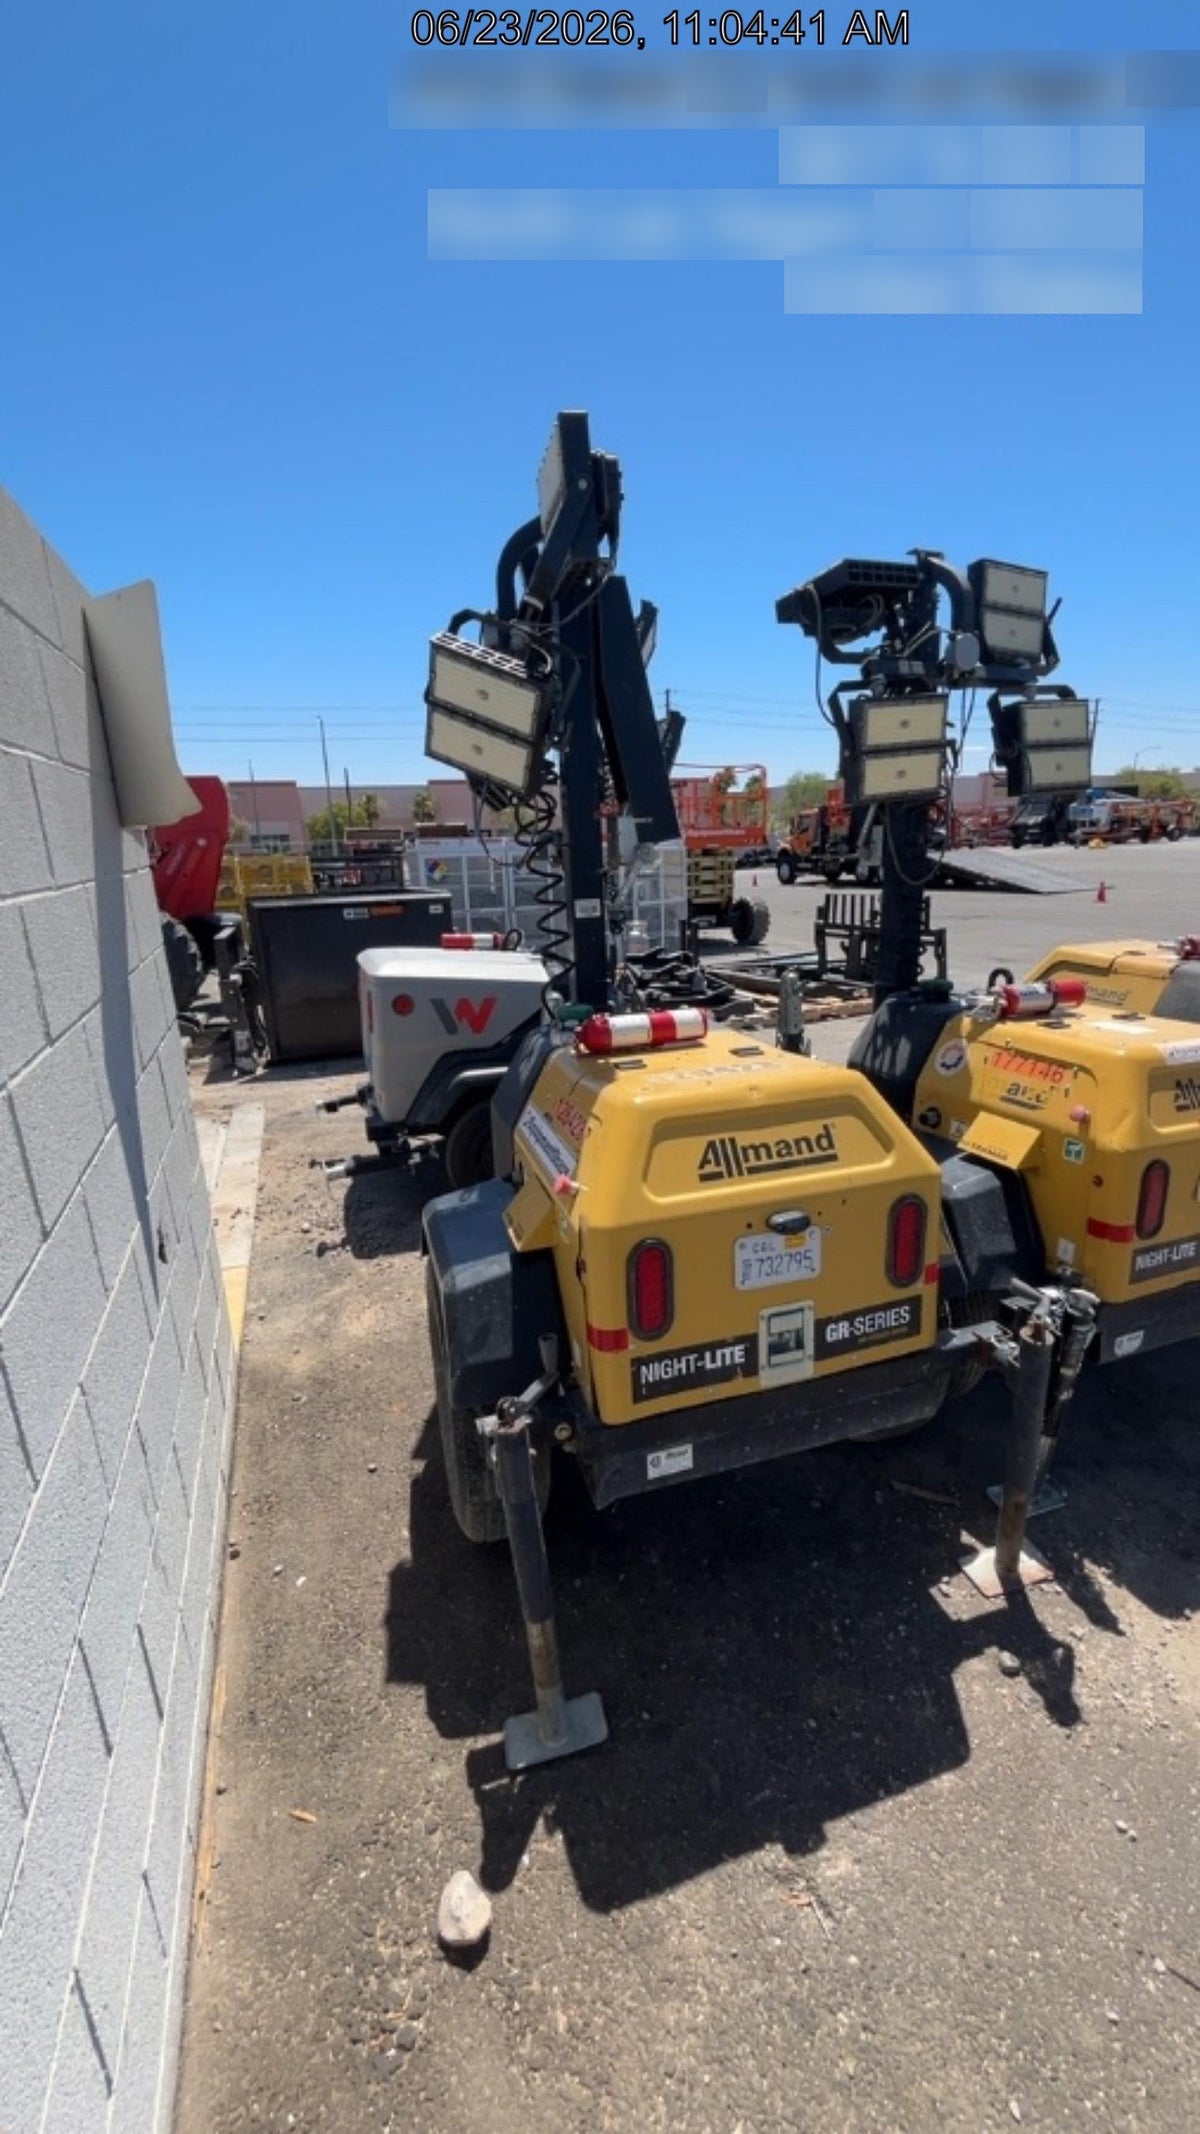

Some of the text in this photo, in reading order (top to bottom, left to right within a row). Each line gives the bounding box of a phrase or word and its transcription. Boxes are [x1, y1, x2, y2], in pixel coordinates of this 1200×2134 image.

[697, 1123, 837, 1179] Allmand
[755, 1249, 815, 1278] 732795
[1135, 1242, 1197, 1272] NIGHT-LITE
[825, 1305, 911, 1343] GR-SERIES
[640, 1343, 747, 1385] NIGHT-LITE
